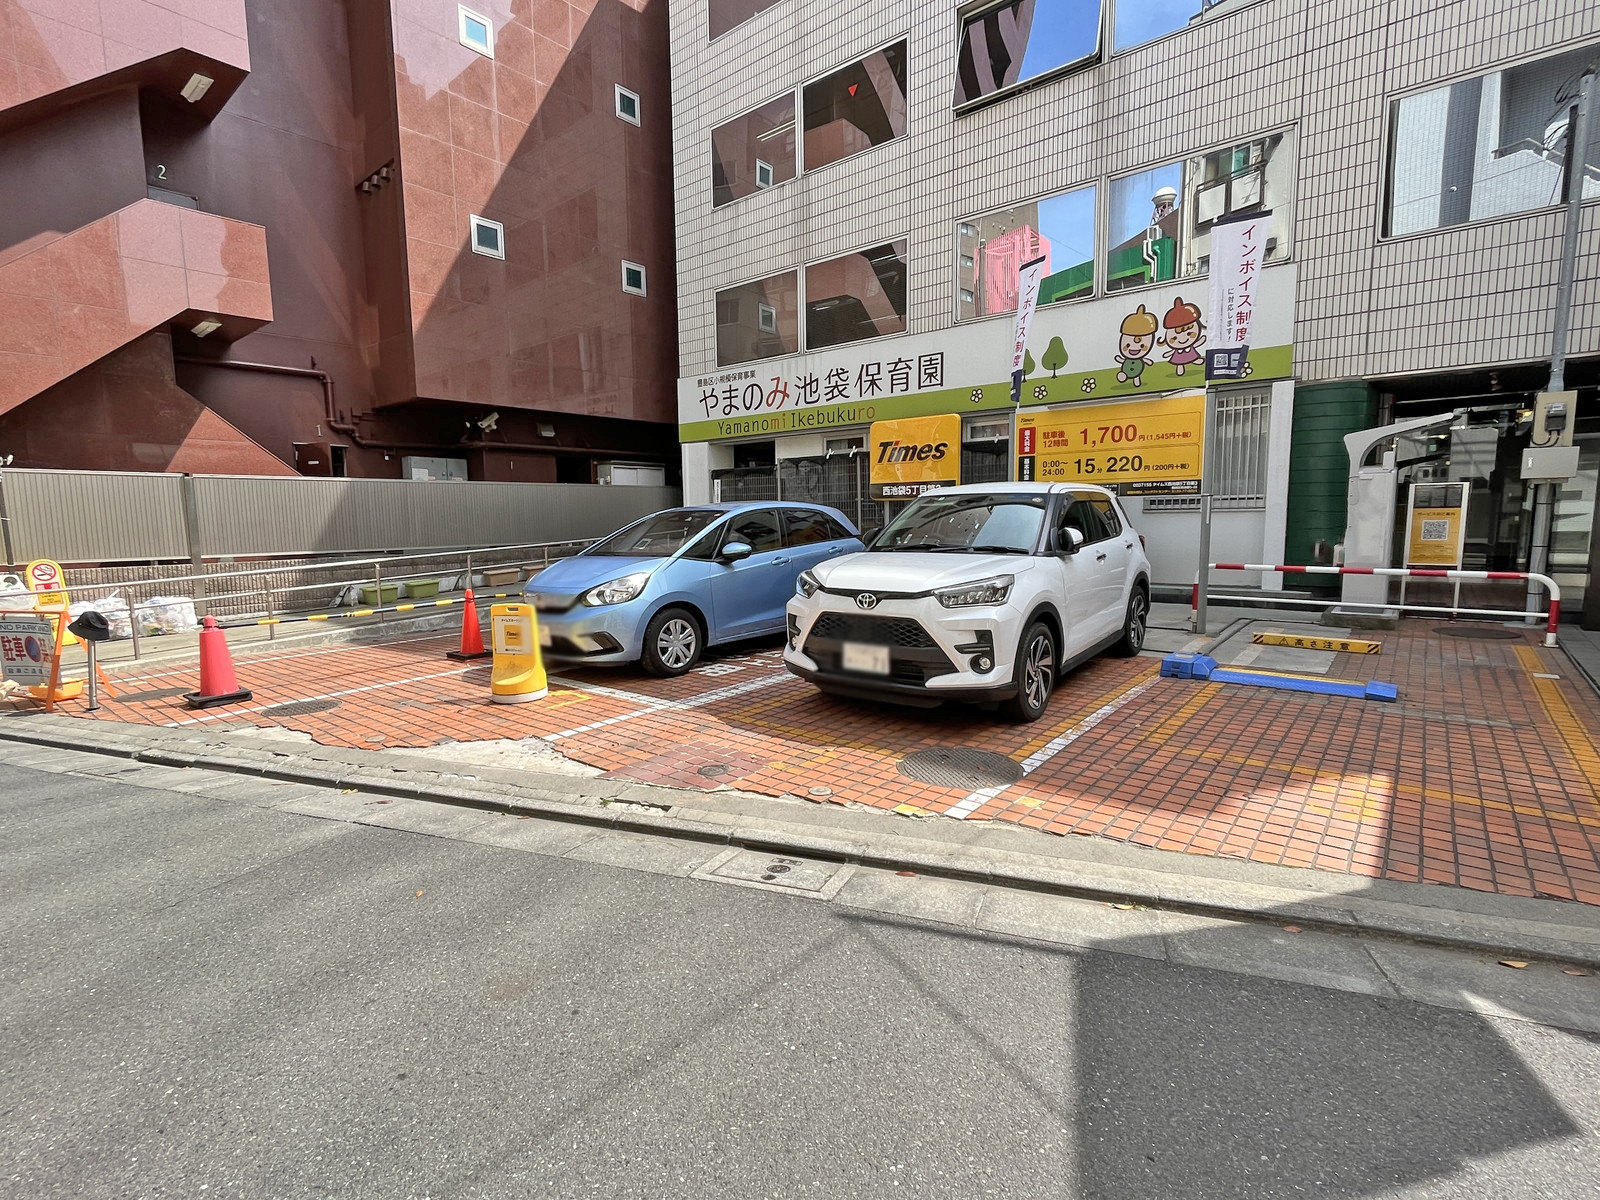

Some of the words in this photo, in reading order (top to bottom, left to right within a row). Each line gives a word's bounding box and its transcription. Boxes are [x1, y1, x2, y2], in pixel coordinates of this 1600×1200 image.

[157, 164, 167, 180] 2
[1235, 225, 1257, 342] インボイス制度
[1012, 268, 1038, 367] インボイス制度
[699, 351, 945, 418] やまのみ池袋保育園
[717, 412, 787, 436] Yamanomi
[791, 405, 876, 429] Ikebukuro
[877, 440, 949, 464] Times
[1042, 468, 1065, 476] 24:00
[1294, 638, 1350, 651] 高さ注意
